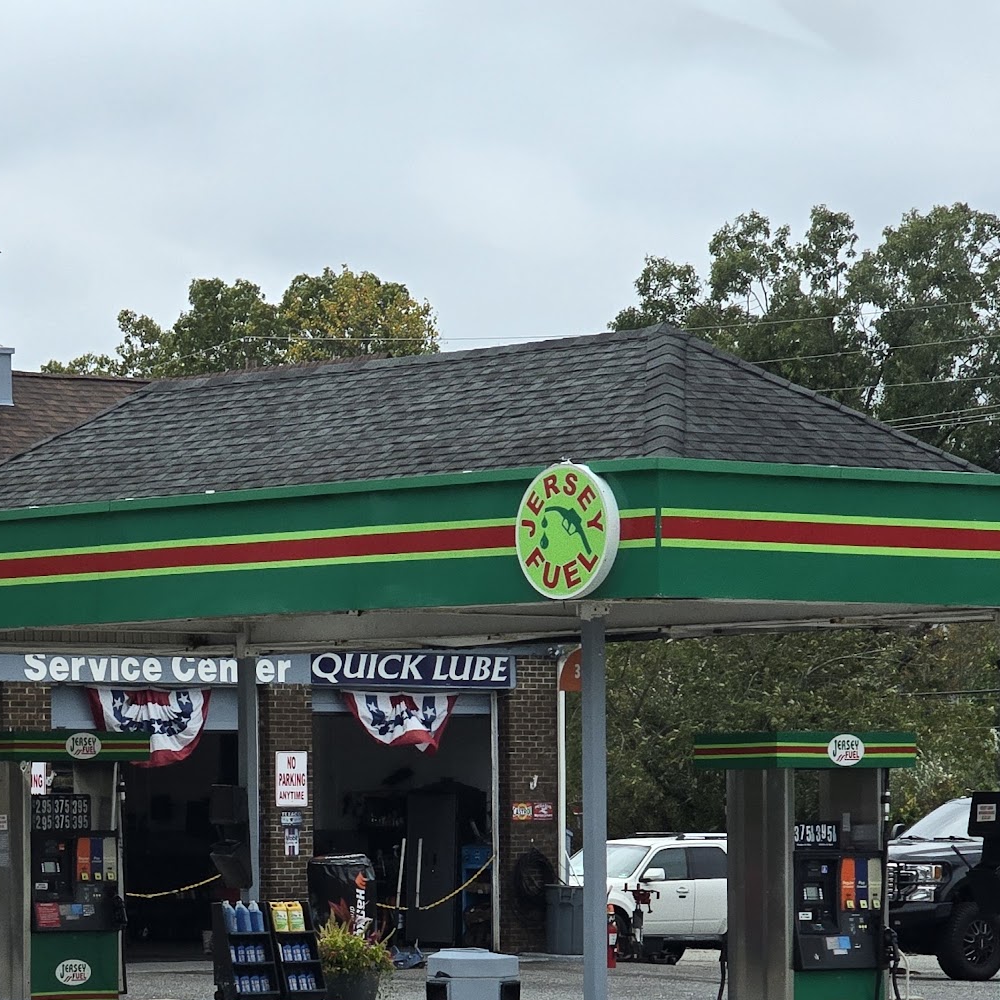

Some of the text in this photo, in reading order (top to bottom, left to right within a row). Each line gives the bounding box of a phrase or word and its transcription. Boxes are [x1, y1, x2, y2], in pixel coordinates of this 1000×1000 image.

[521, 473, 604, 537] JERSEY
[525, 547, 599, 589] FUEL
[24, 654, 291, 683] Service Cener
[311, 652, 509, 684] QUICK LUBE
[69, 737, 97, 752] JERSEY
[81, 746, 96, 754] FUEL
[832, 739, 860, 757] JERSEY
[286, 756, 297, 769] NO
[845, 750, 860, 759] FUEL
[278, 773, 306, 787] PARKING
[279, 791, 305, 800] ANYTIME
[35, 799, 88, 815] 295 375 395
[35, 814, 89, 830] 295 375 395
[60, 963, 87, 979] JERSEY
[72, 972, 87, 980] FUEL
